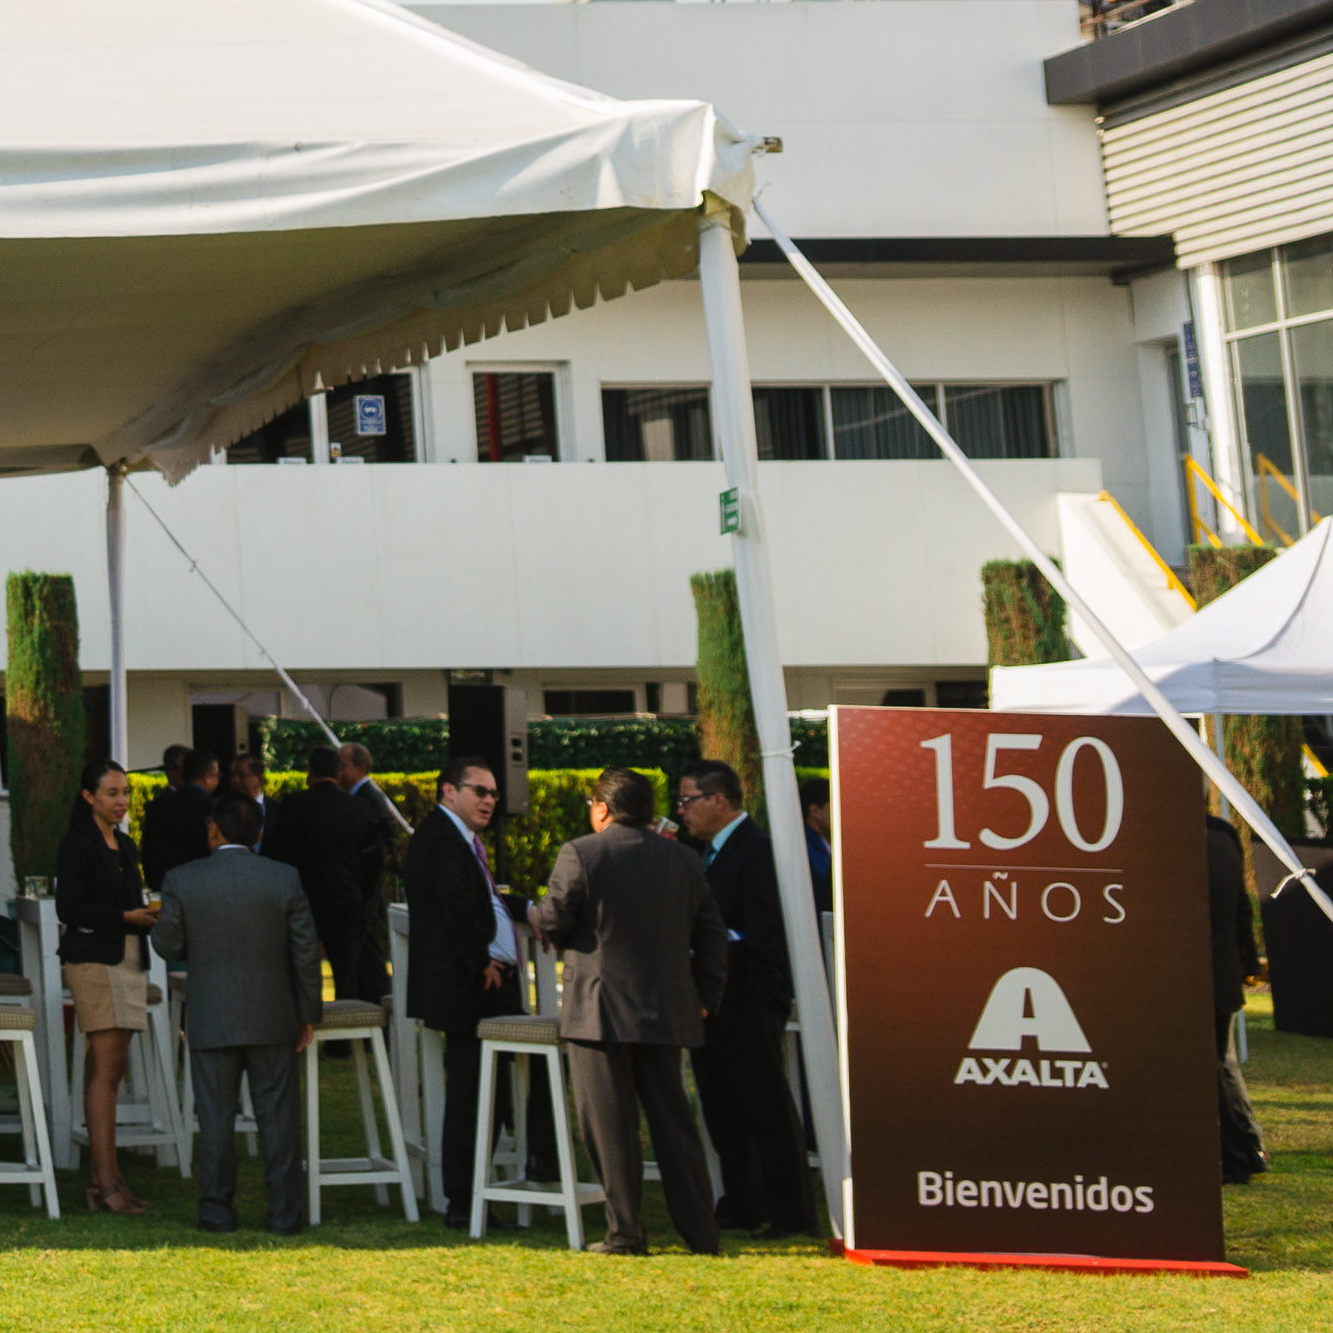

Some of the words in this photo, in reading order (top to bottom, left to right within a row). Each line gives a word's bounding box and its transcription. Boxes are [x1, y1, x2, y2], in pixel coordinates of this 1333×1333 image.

[920, 733, 1124, 852] 150
[924, 871, 1126, 924] AÑOS
[954, 1057, 1109, 1089] AXALTA
[917, 1171, 1154, 1213] Bienvenidos
